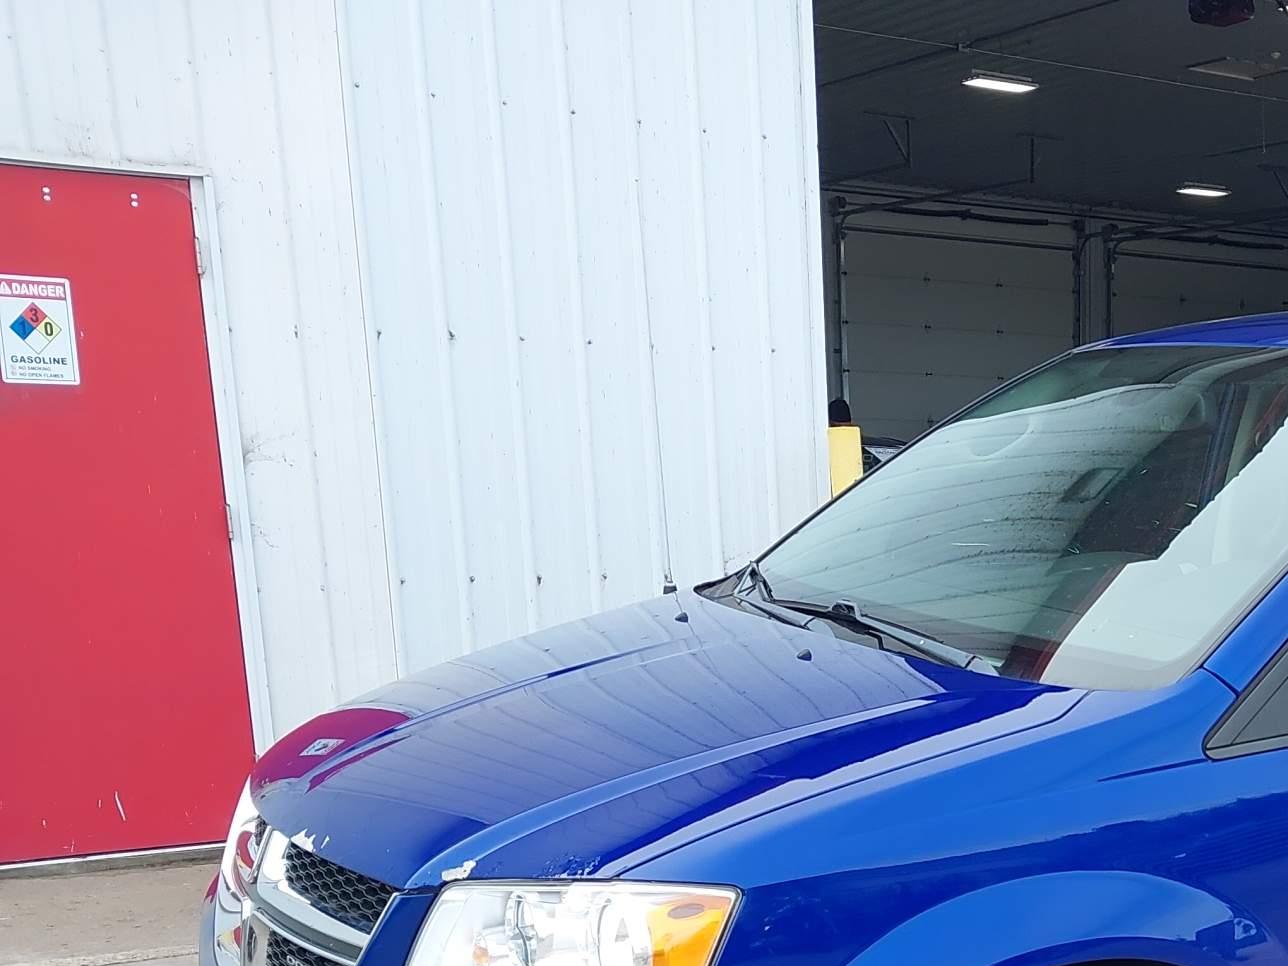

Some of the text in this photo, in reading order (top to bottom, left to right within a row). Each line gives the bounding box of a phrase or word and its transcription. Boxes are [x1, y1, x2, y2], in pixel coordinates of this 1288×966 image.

[12, 282, 65, 298] DANGER
[30, 308, 39, 323] 3
[44, 322, 53, 336] 0
[11, 355, 68, 365] GASOLINE
